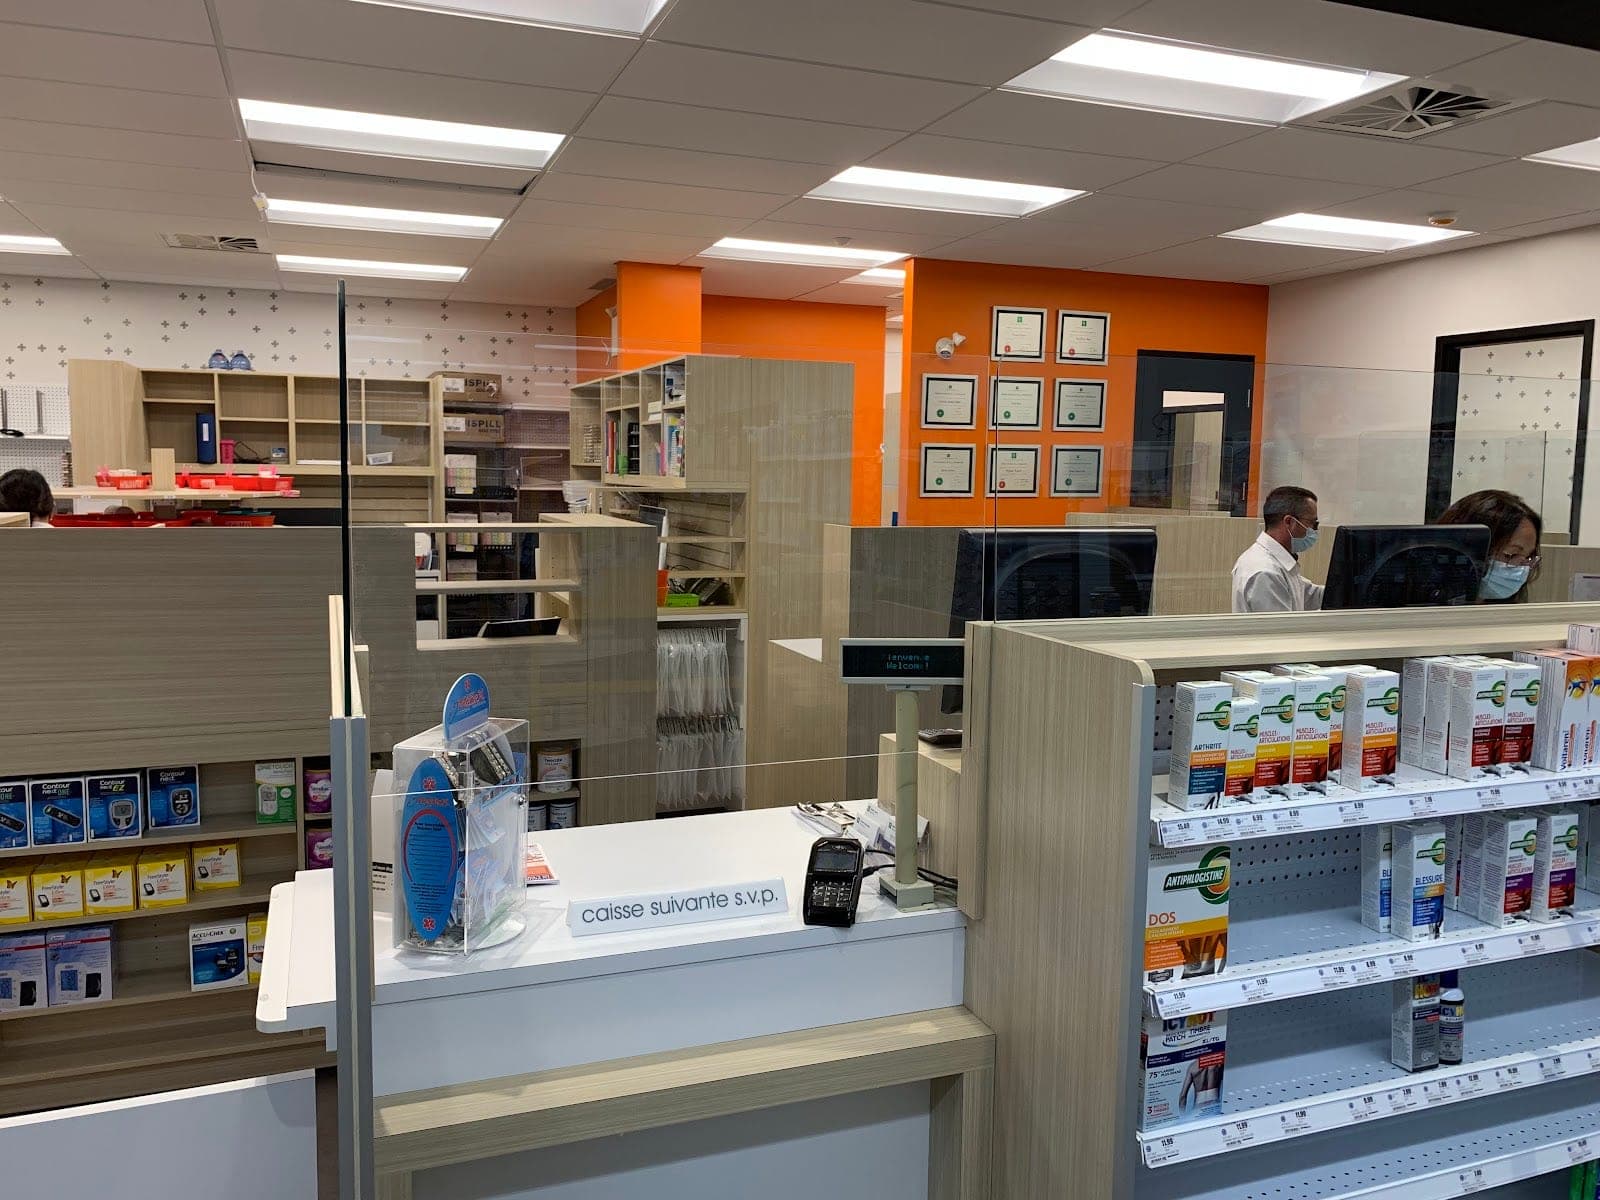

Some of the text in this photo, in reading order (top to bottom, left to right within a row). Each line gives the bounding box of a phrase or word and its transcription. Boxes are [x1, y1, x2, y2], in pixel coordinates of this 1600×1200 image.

[112, 784, 125, 792] EZ
[1166, 869, 1225, 888] ANTIPHLOGISTINE
[1415, 873, 1443, 886] BLESSURE
[582, 888, 779, 924] caisse suivante s.v.p.
[1149, 911, 1176, 926] DOS
[1147, 1106, 1152, 1115] 3
